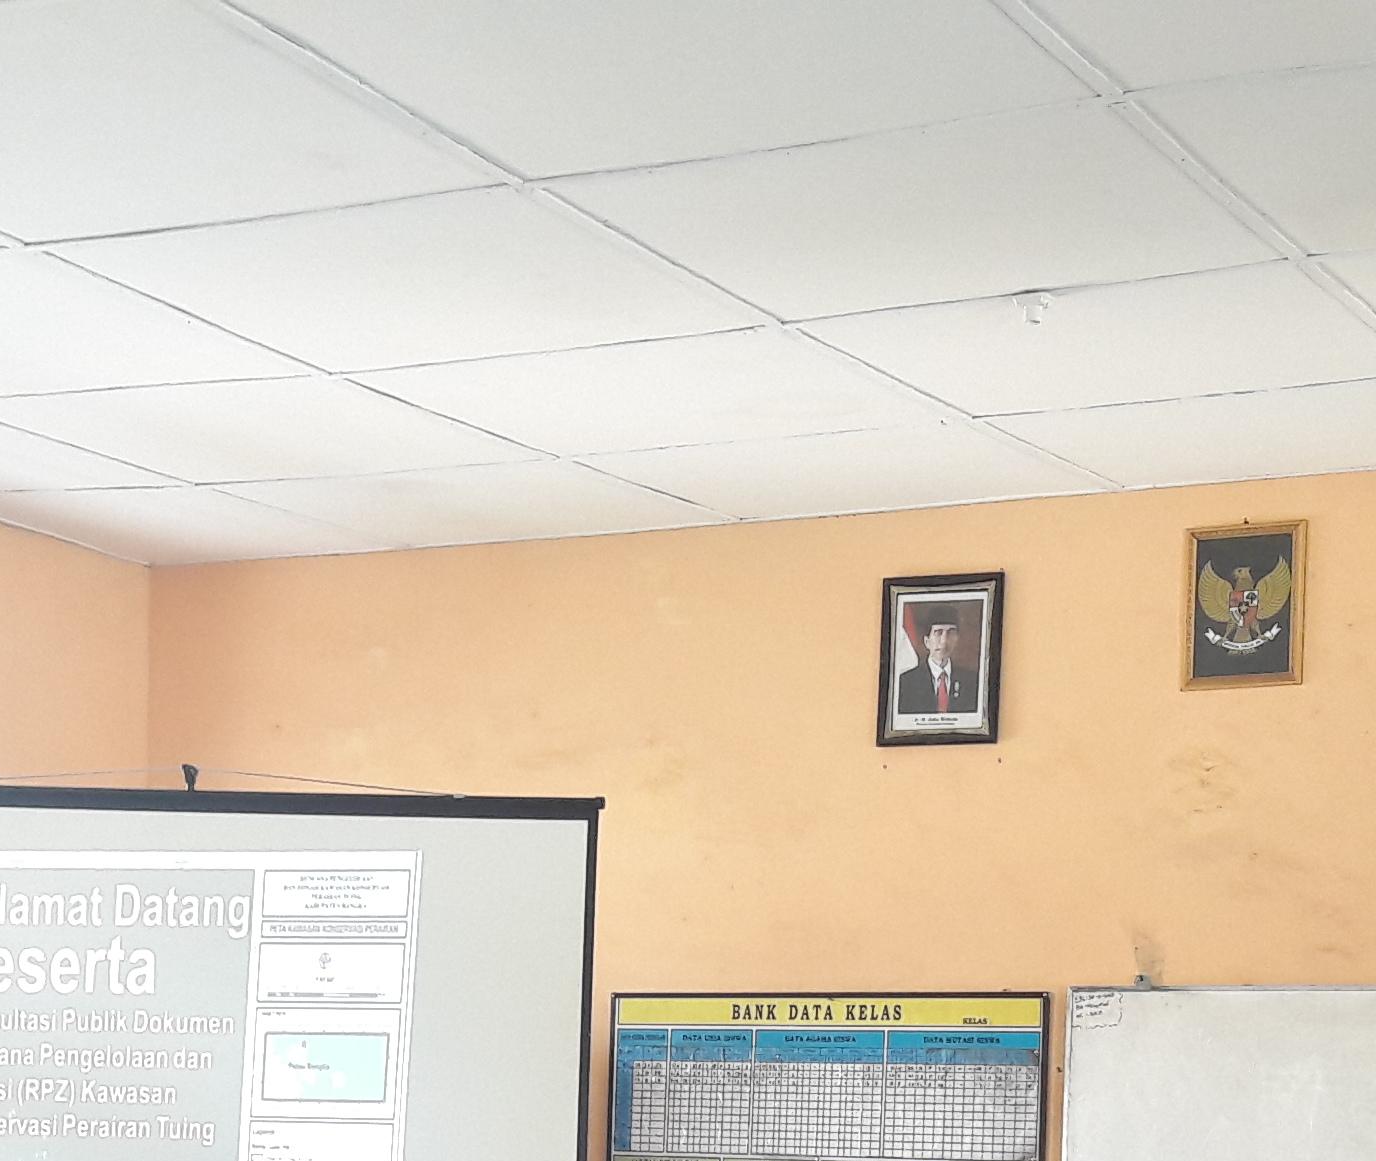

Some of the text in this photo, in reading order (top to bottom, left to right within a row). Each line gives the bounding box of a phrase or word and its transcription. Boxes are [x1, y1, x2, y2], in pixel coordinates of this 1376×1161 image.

[114, 883, 251, 938] Datang
[62, 1009, 128, 1033] Publik
[133, 1010, 235, 1035] Dokumen
[732, 1004, 903, 1021] BANK DATA KELAS
[40, 1044, 168, 1073] Pengelolaan
[174, 1048, 212, 1069] dan
[17, 1078, 75, 1106] (RPZ)
[80, 1080, 176, 1105] Kawasan
[62, 1113, 151, 1138] Perairan
[157, 1115, 215, 1146] Tuing
